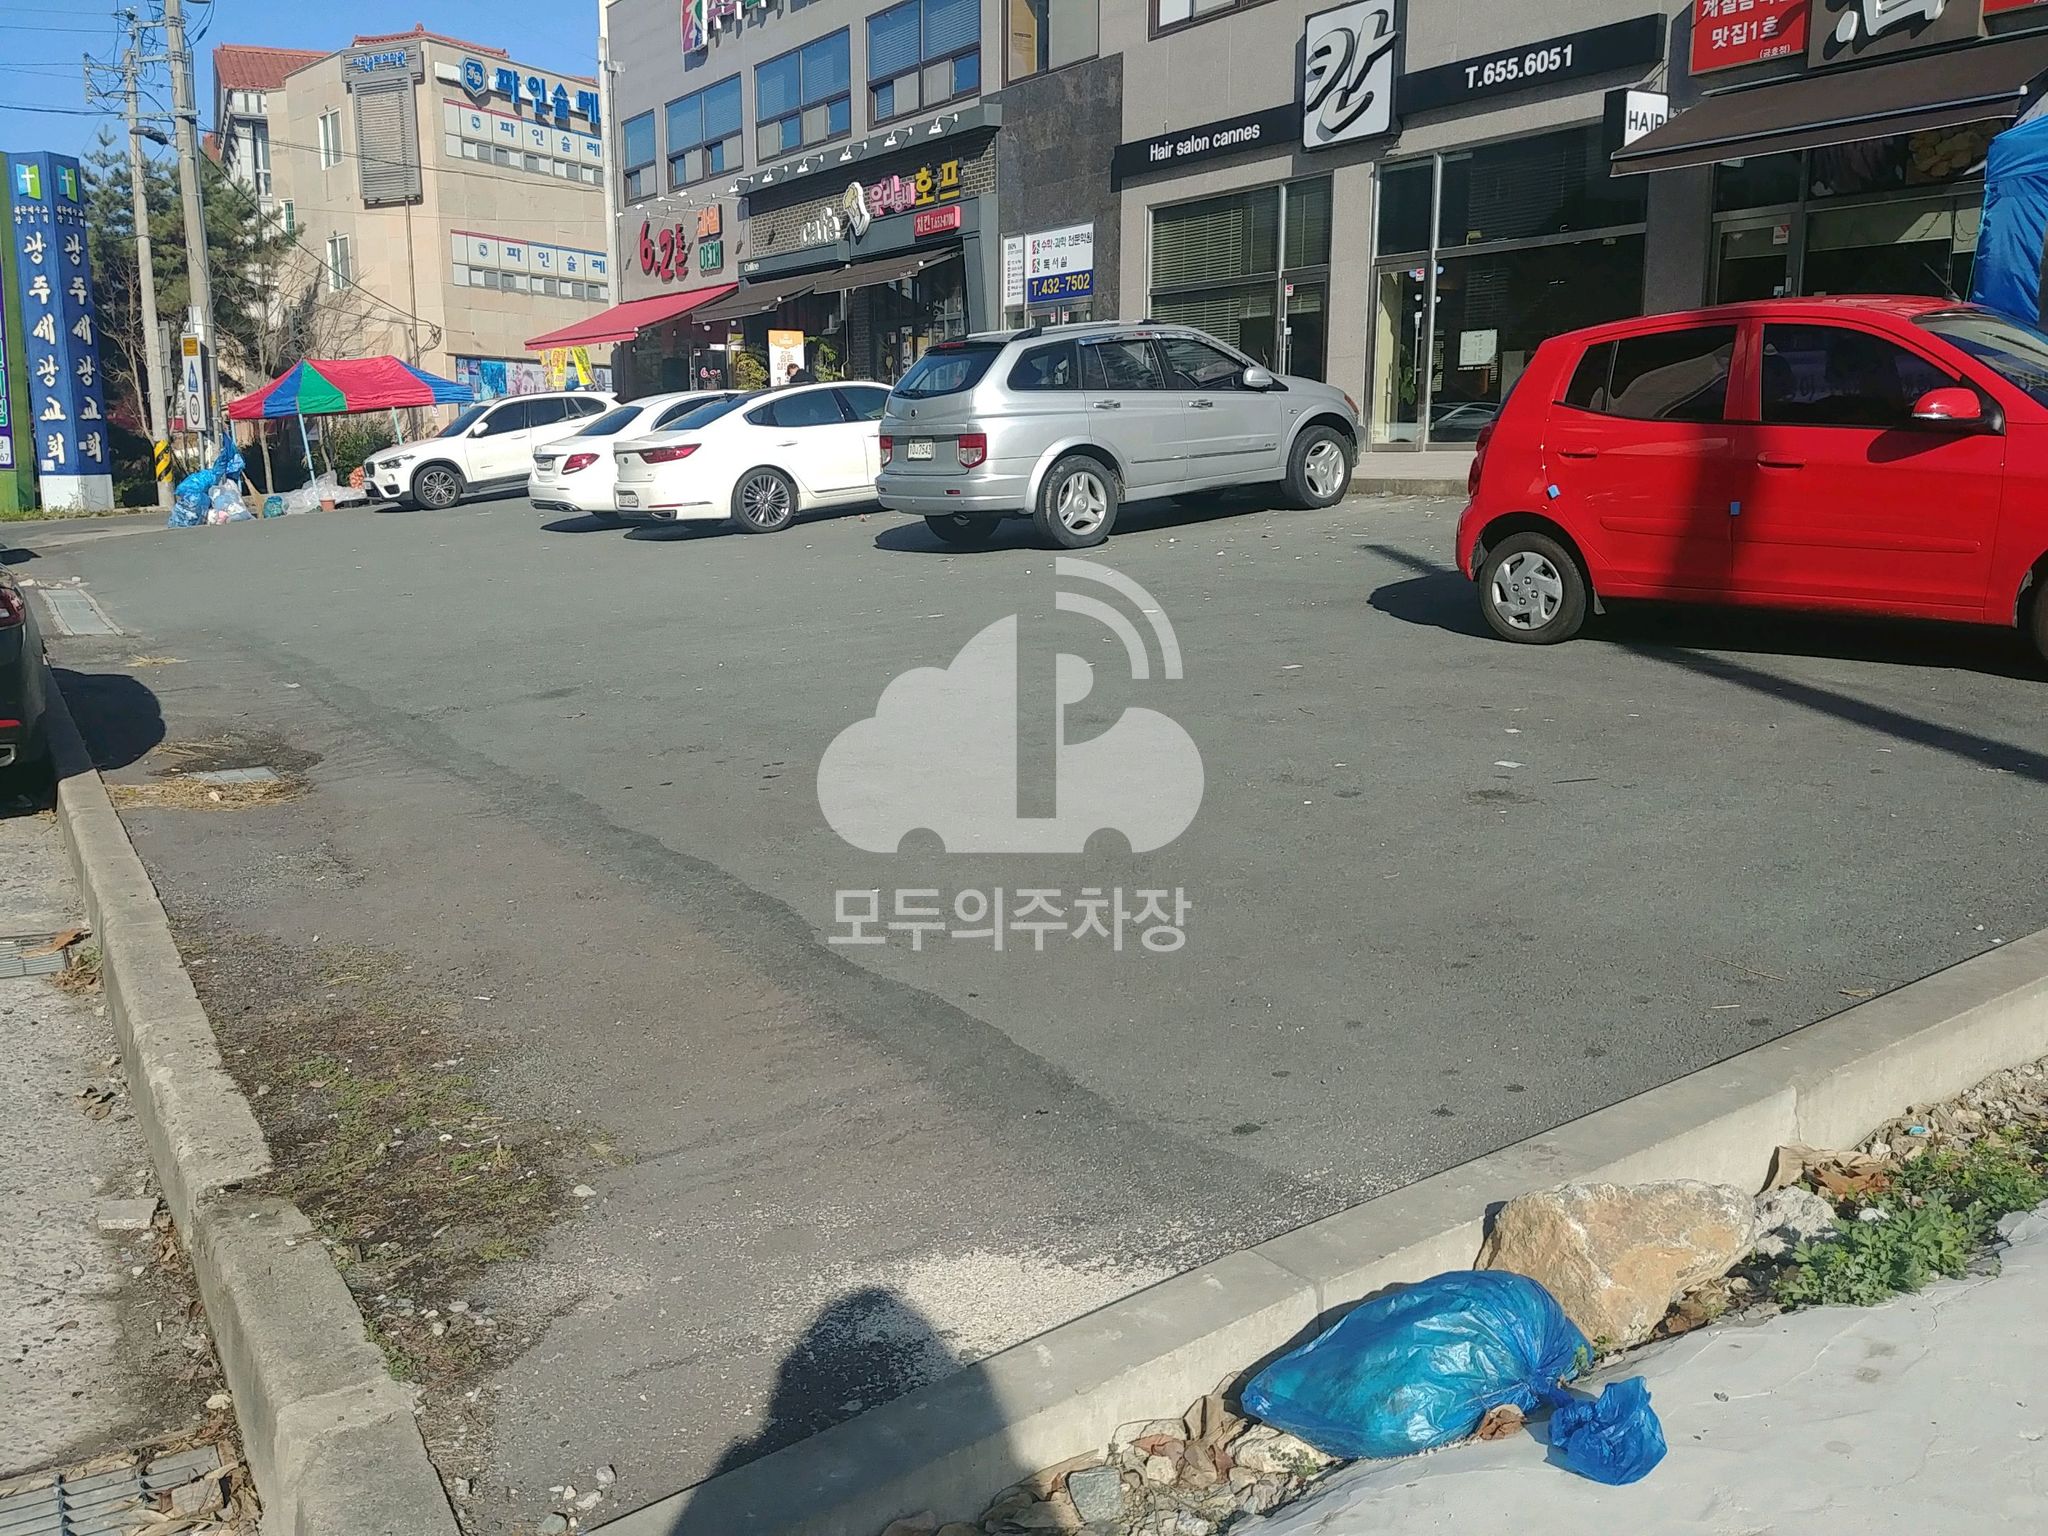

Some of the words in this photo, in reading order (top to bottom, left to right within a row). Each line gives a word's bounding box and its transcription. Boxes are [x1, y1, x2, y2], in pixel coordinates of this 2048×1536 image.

[1711, 15, 1779, 50] 맛집1호
[1465, 44, 1573, 89] T.655.6051
[1629, 110, 1664, 132] HAIR
[1150, 141, 1174, 161] Hair
[1176, 135, 1210, 156] salon
[1212, 124, 1261, 148] cannes
[916, 159, 961, 206] 호프
[1031, 272, 1090, 297] T.432-7502
